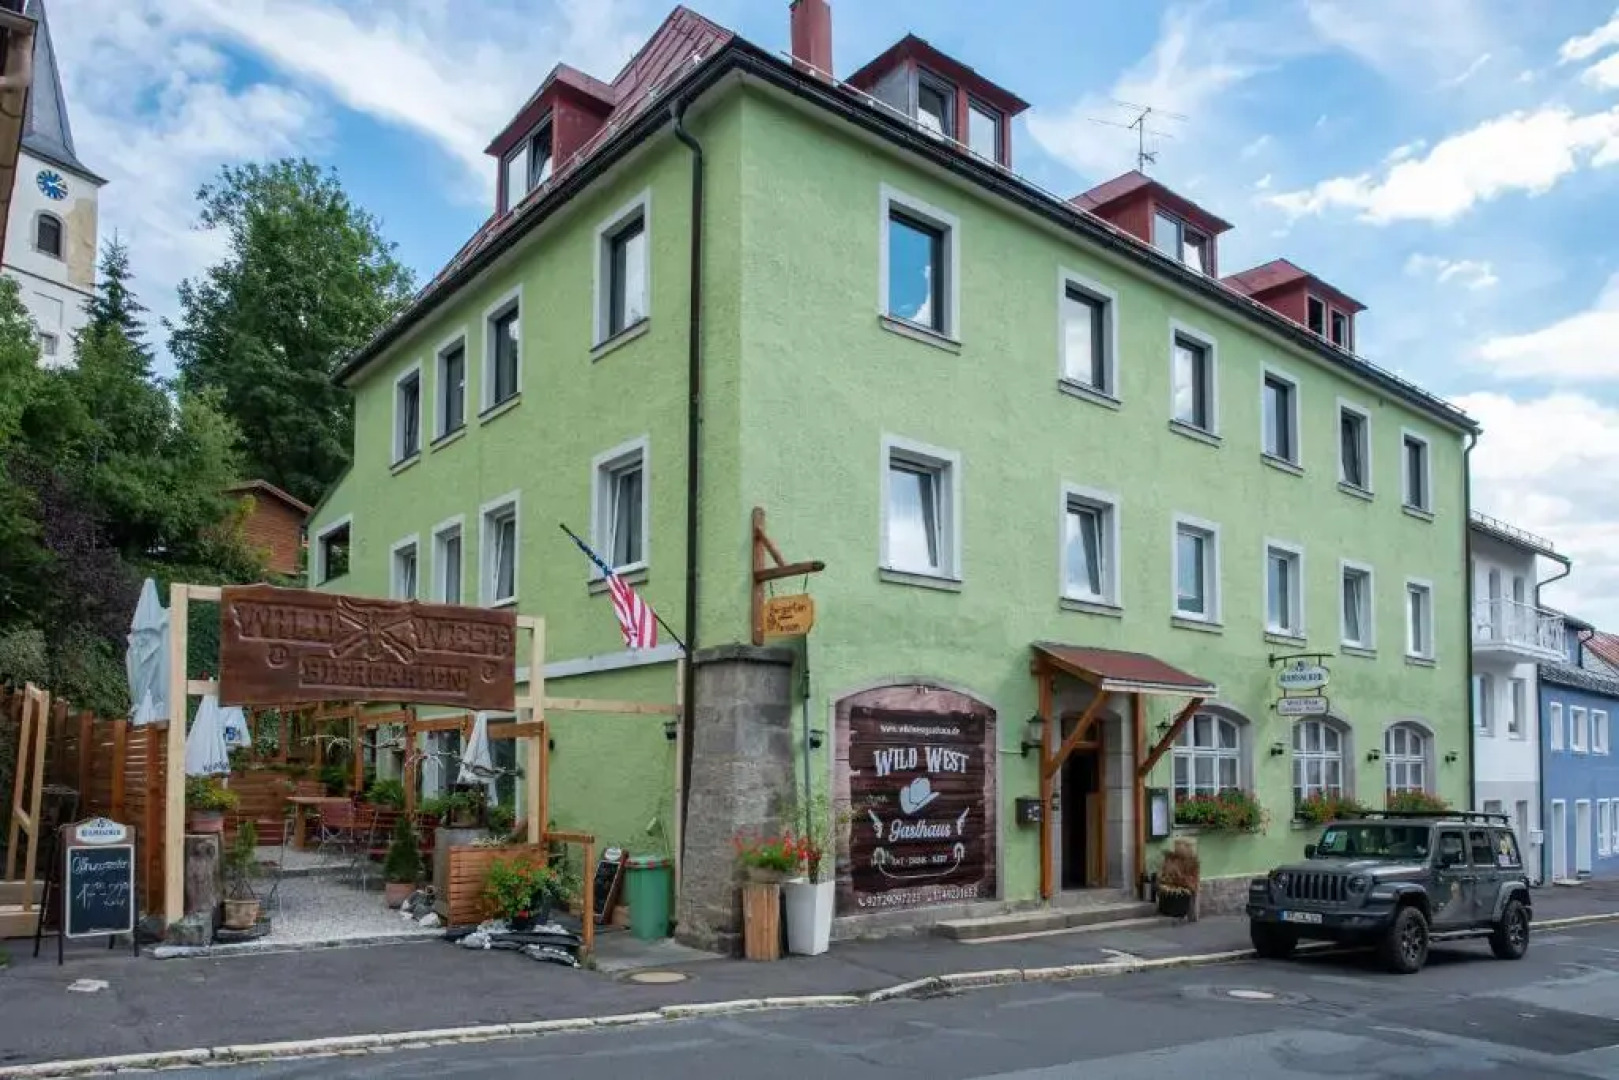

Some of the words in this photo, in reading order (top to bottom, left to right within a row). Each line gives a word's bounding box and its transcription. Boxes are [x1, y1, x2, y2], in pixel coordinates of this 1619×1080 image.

[239, 602, 332, 641] WILD
[414, 617, 510, 656] WEST
[303, 658, 469, 693] BIERGARTEN
[888, 818, 951, 842] Gasthaus
